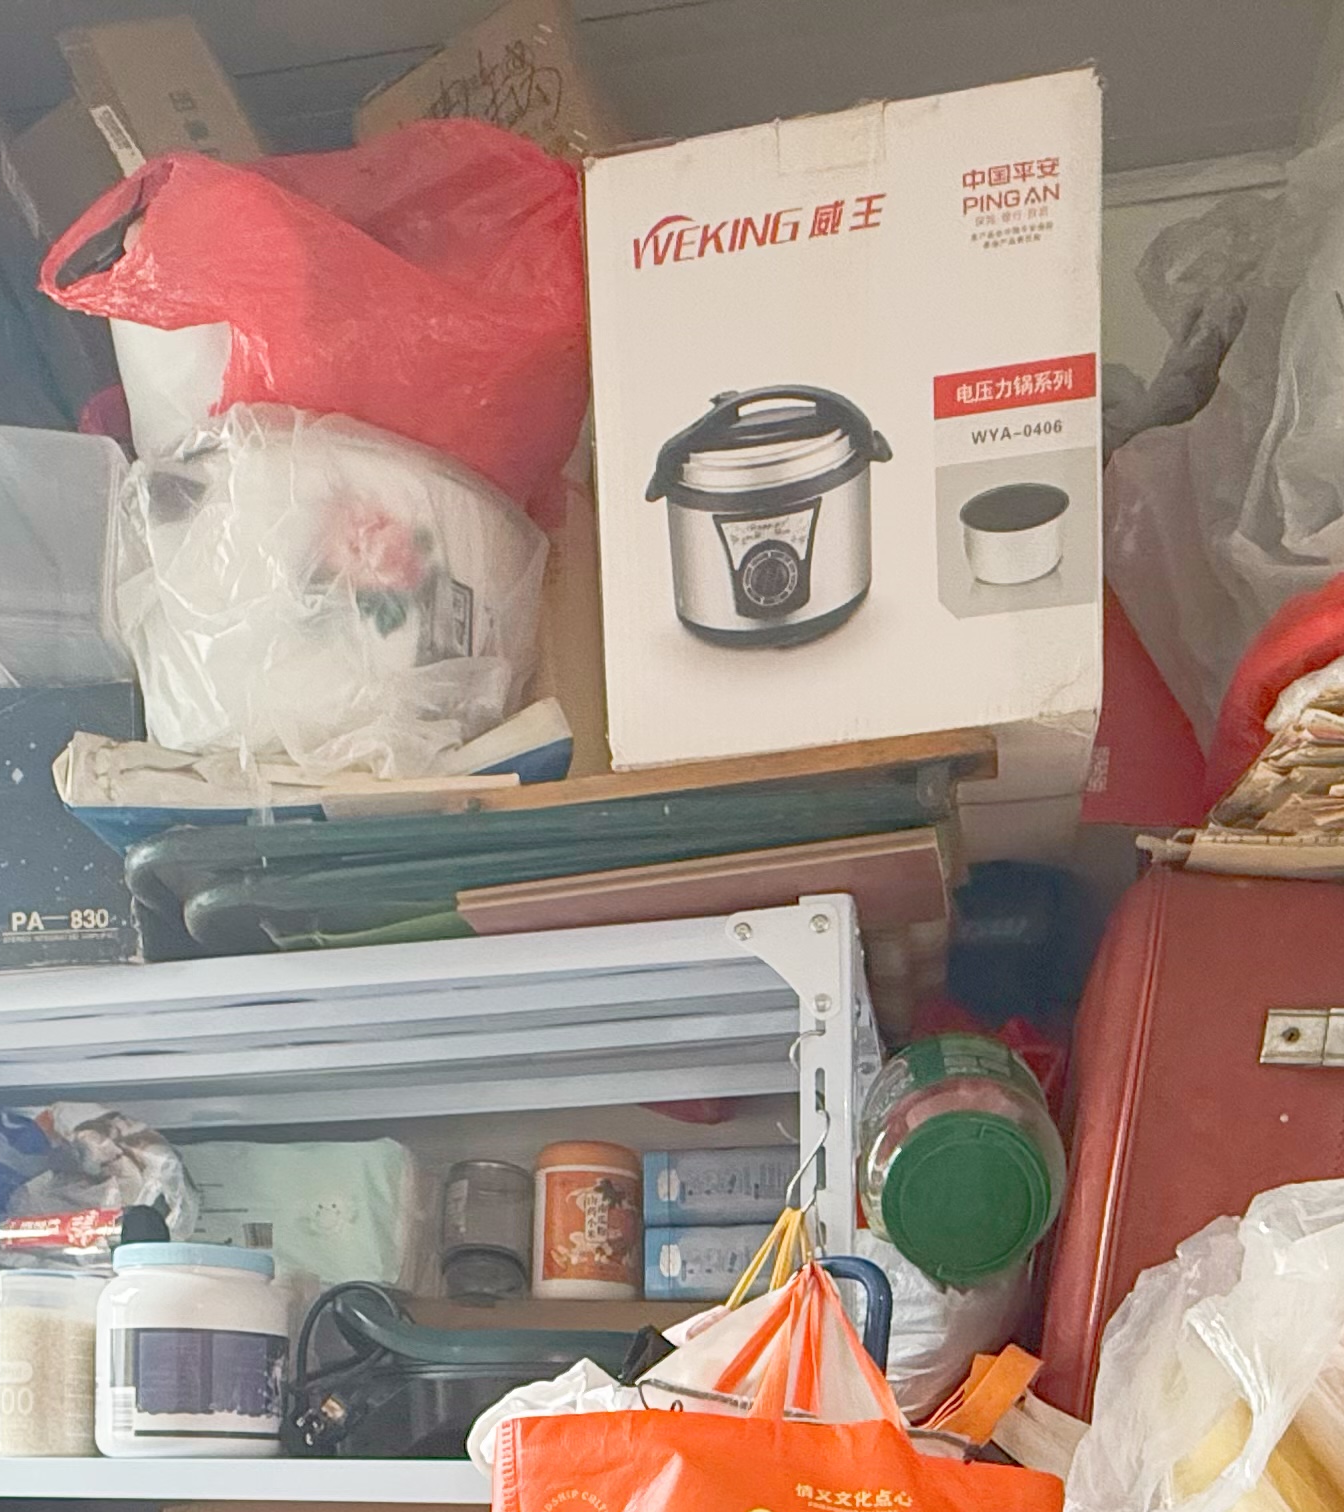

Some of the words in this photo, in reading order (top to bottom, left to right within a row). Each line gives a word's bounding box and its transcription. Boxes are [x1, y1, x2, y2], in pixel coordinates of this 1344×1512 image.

[962, 157, 1060, 191] 中国平安
[962, 189, 1021, 216] PING
[1024, 183, 1060, 206] AN
[808, 192, 887, 241] 威王
[956, 367, 1074, 407] 电压力锅系列
[971, 419, 1063, 446] WYA-0406
[795, 1482, 913, 1508] 情义文化点心
